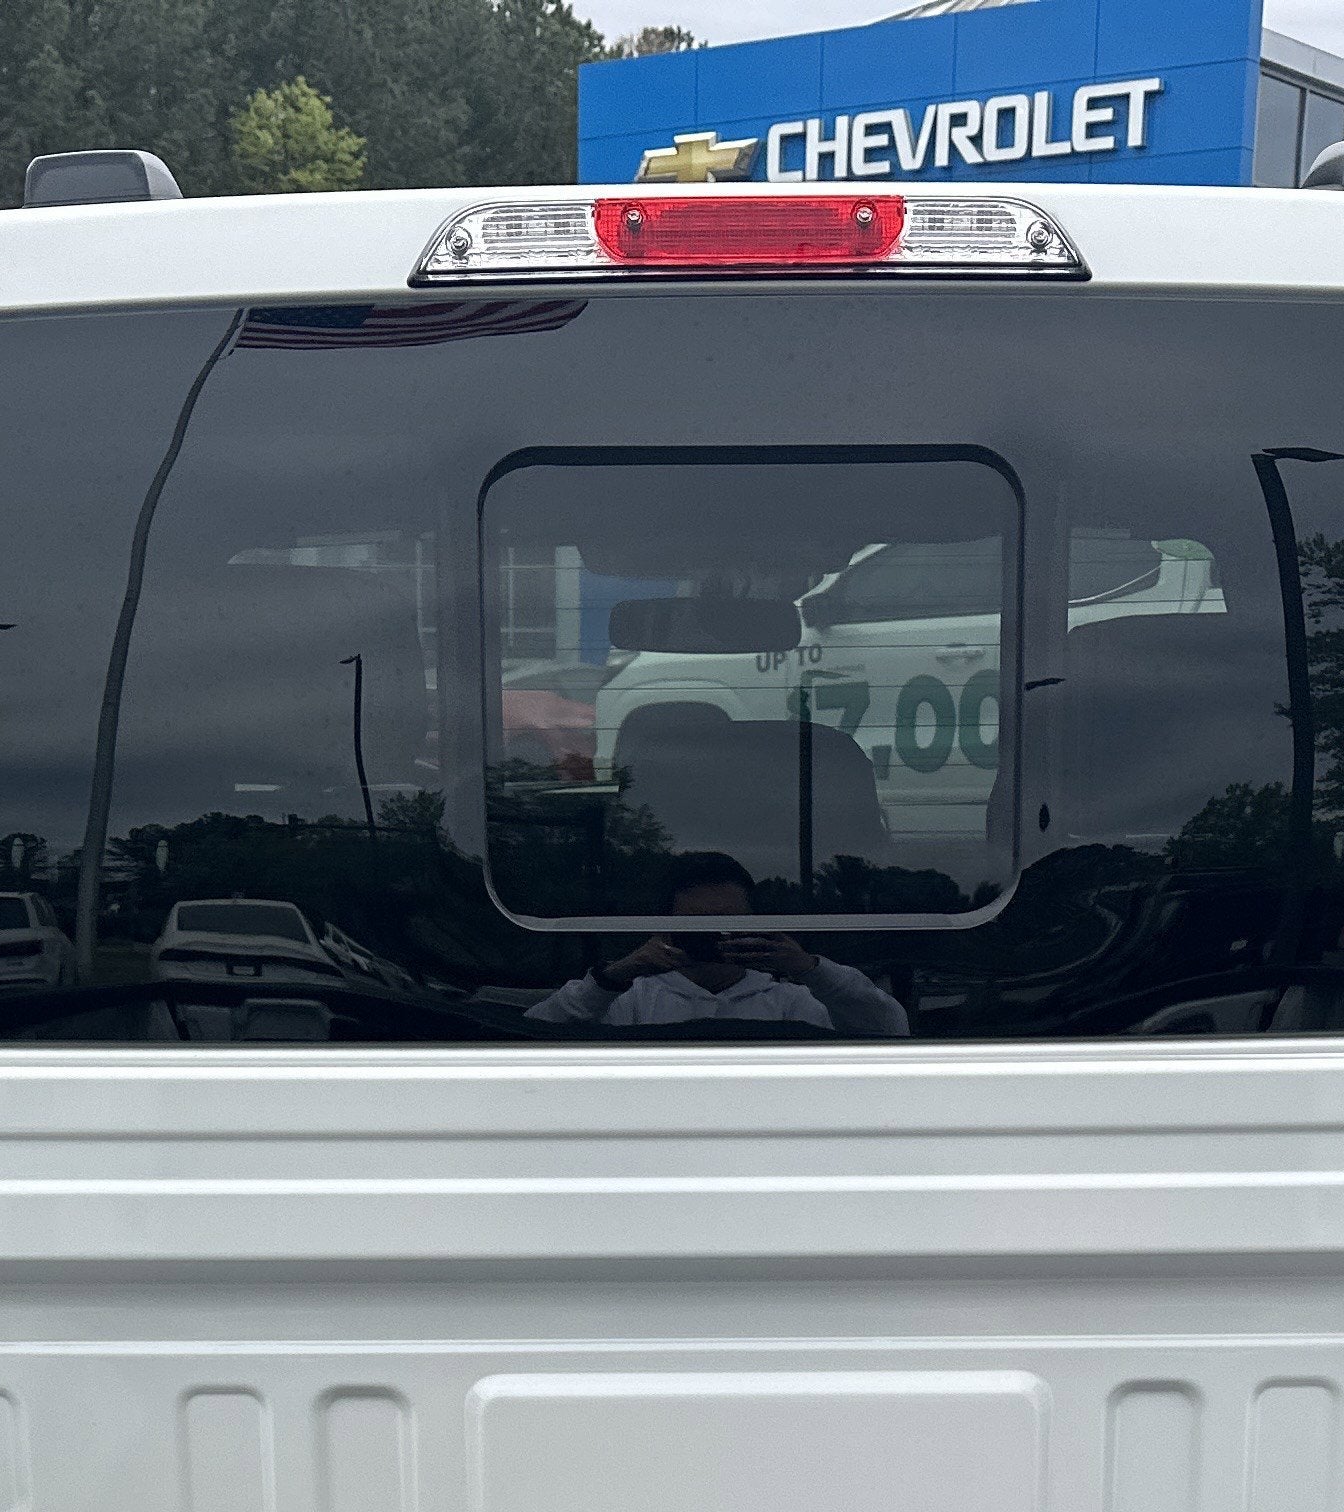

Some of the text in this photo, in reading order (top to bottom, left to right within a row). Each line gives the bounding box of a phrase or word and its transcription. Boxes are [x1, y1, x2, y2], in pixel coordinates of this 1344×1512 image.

[766, 77, 1163, 182] CHEVROLET
[756, 642, 823, 673] UP TO
